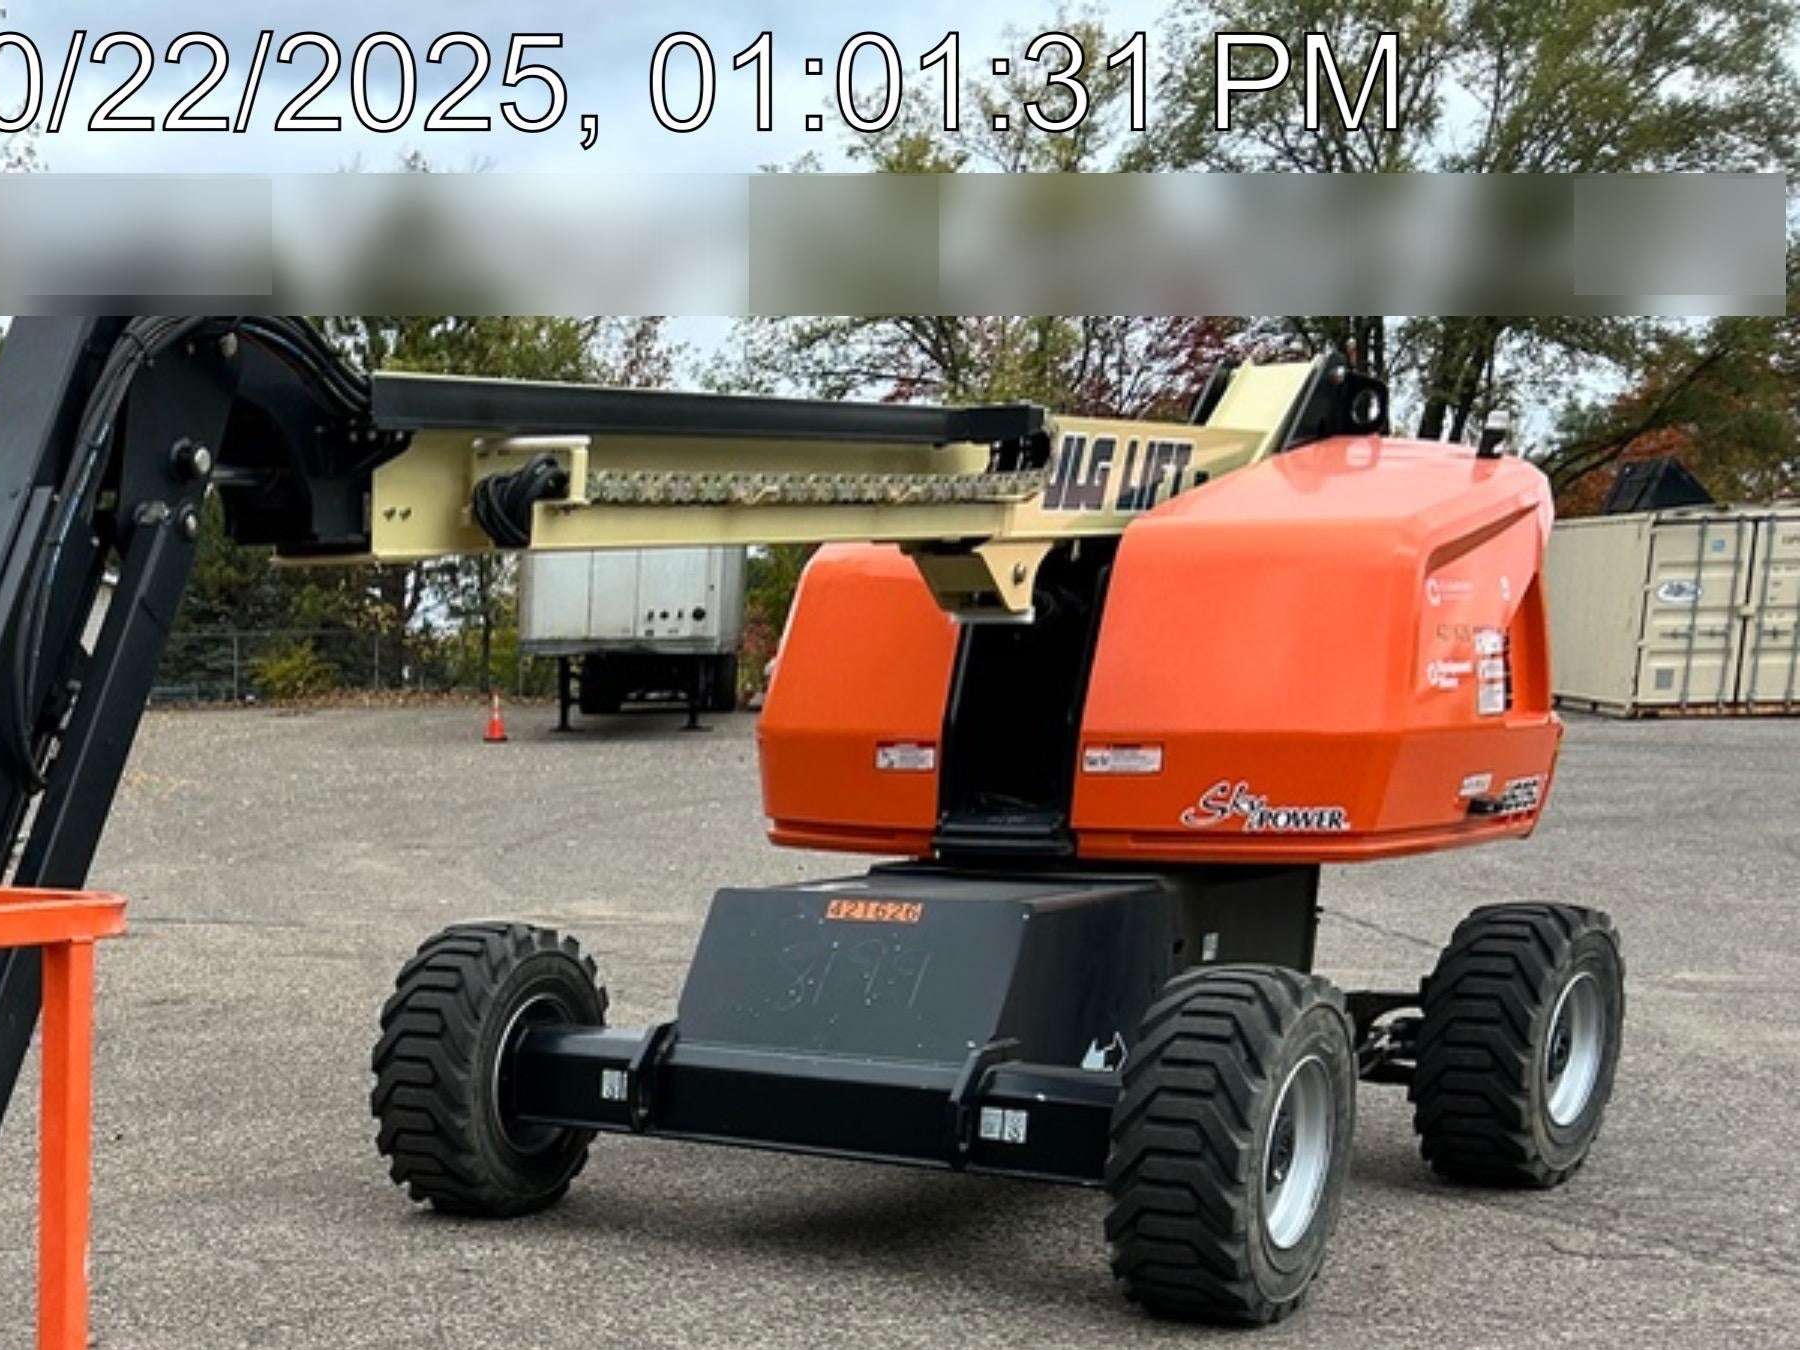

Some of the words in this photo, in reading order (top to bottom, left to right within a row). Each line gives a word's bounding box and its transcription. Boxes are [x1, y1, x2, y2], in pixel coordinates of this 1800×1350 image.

[1043, 433, 1117, 511] JLG
[1114, 437, 1194, 511] LIFT
[1180, 779, 1269, 833] Sky
[1253, 806, 1348, 831] POWER
